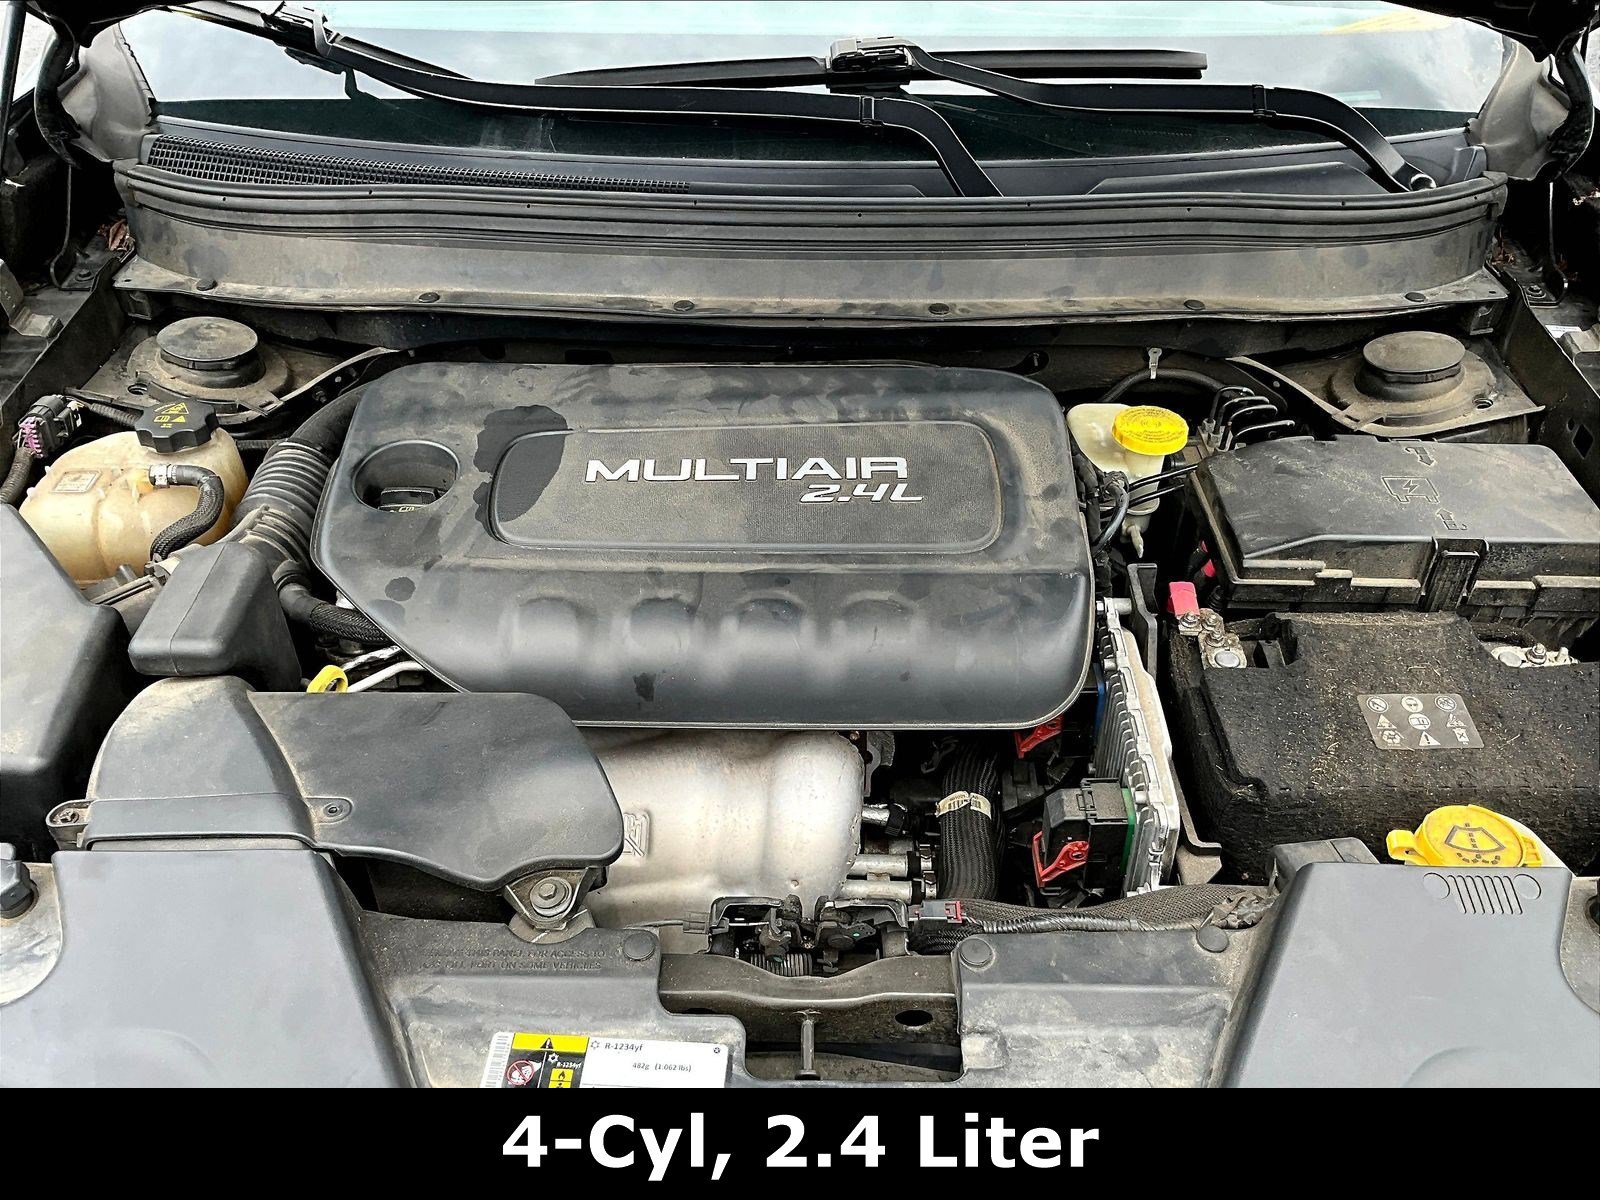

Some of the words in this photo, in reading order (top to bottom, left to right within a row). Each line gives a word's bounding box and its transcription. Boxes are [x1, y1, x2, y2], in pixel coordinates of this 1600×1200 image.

[584, 457, 909, 482] MULTIAIR
[799, 483, 924, 503] 2.4L
[500, 960, 517, 969] ON
[518, 960, 548, 969] SOME
[552, 960, 602, 970] VEHICLES
[604, 1042, 643, 1053] R-1234yf
[632, 1062, 650, 1071] 482g
